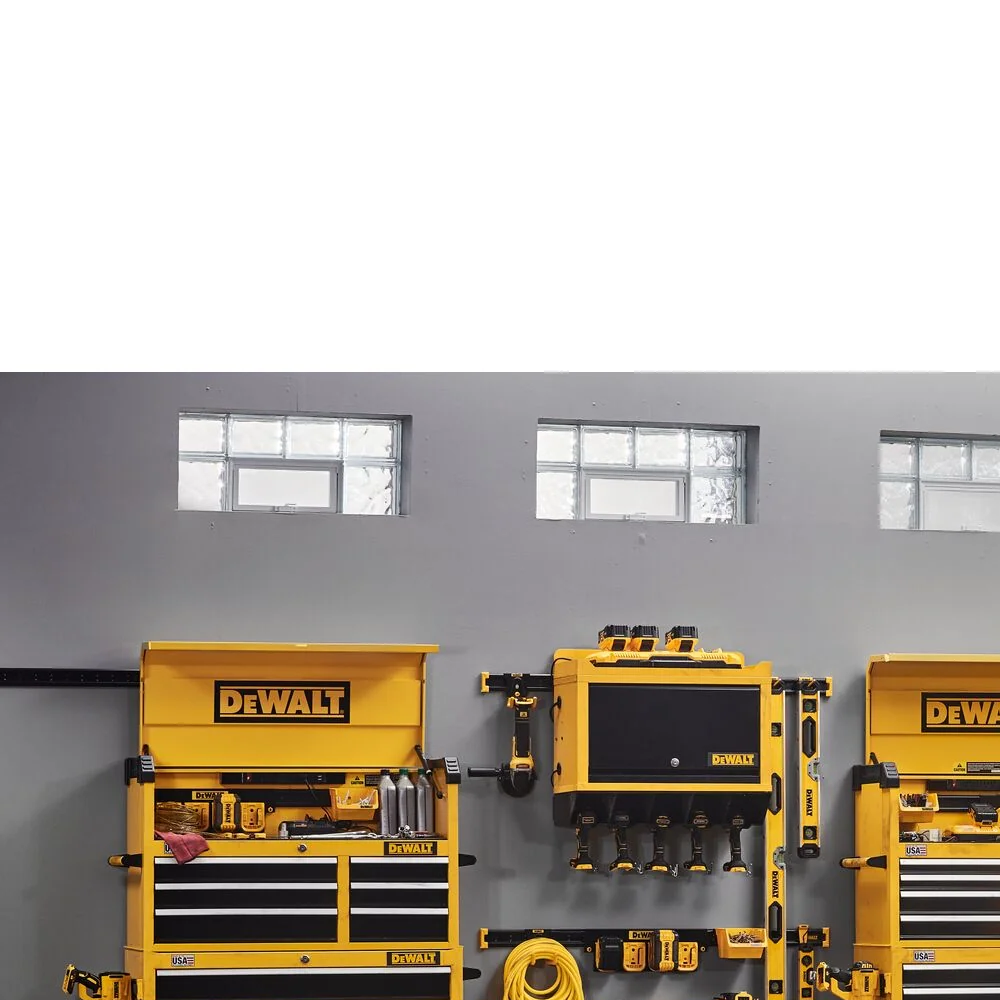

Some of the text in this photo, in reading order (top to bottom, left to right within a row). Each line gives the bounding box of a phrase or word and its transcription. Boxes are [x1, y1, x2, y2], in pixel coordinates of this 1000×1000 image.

[220, 690, 344, 714] DEWALT
[713, 755, 754, 765] DEWALT
[390, 844, 432, 853] DEWALT
[392, 954, 435, 963] DEWALT
